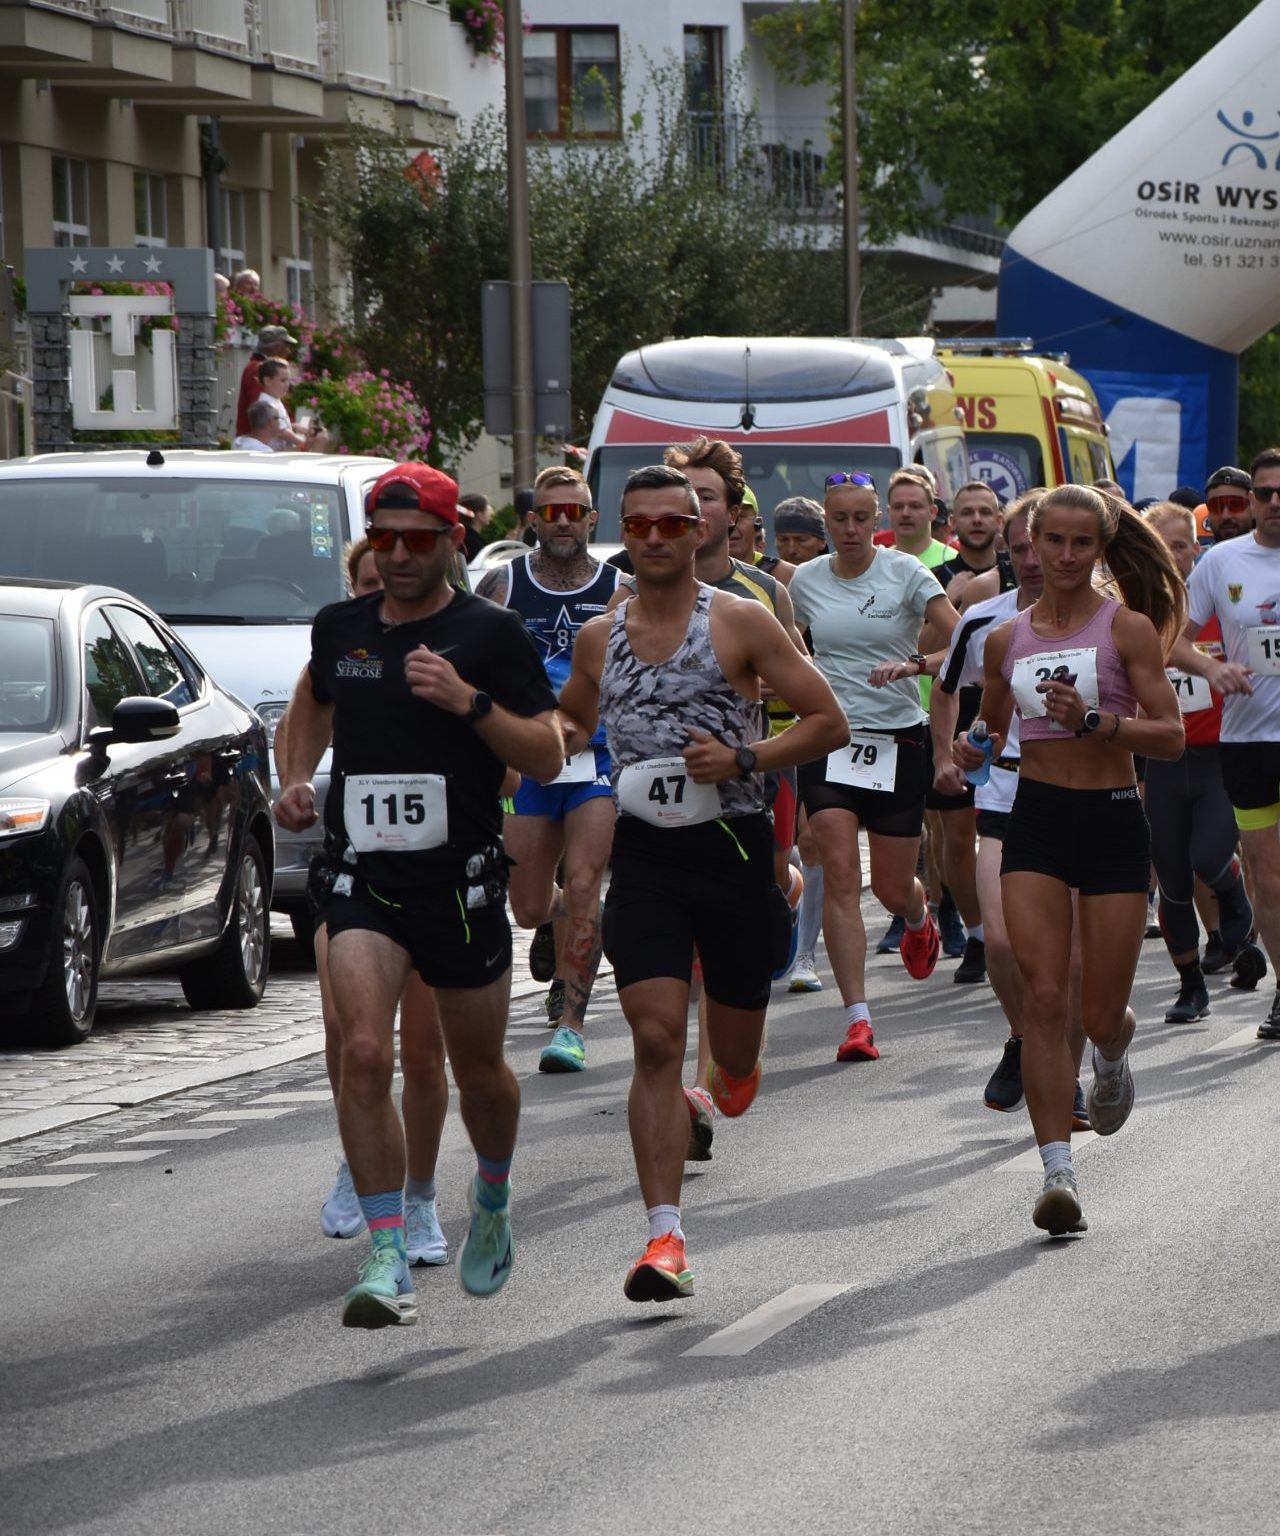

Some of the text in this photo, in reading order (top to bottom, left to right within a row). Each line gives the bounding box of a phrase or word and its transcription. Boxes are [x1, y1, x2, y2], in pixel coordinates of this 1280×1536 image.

[1137, 181, 1200, 205] OSiR
[1135, 207, 1179, 220] Ośrodek
[1183, 211, 1219, 225] Sportu
[1229, 216, 1280, 230] Rekreacji
[1183, 253, 1207, 267] tel.
[1212, 254, 1231, 268] 91
[1237, 254, 1264, 268] 321
[850, 742, 878, 766] 79
[648, 774, 687, 805] 47
[872, 781, 882, 789] 79
[1111, 789, 1136, 801] NIKE
[361, 793, 426, 826] 115
